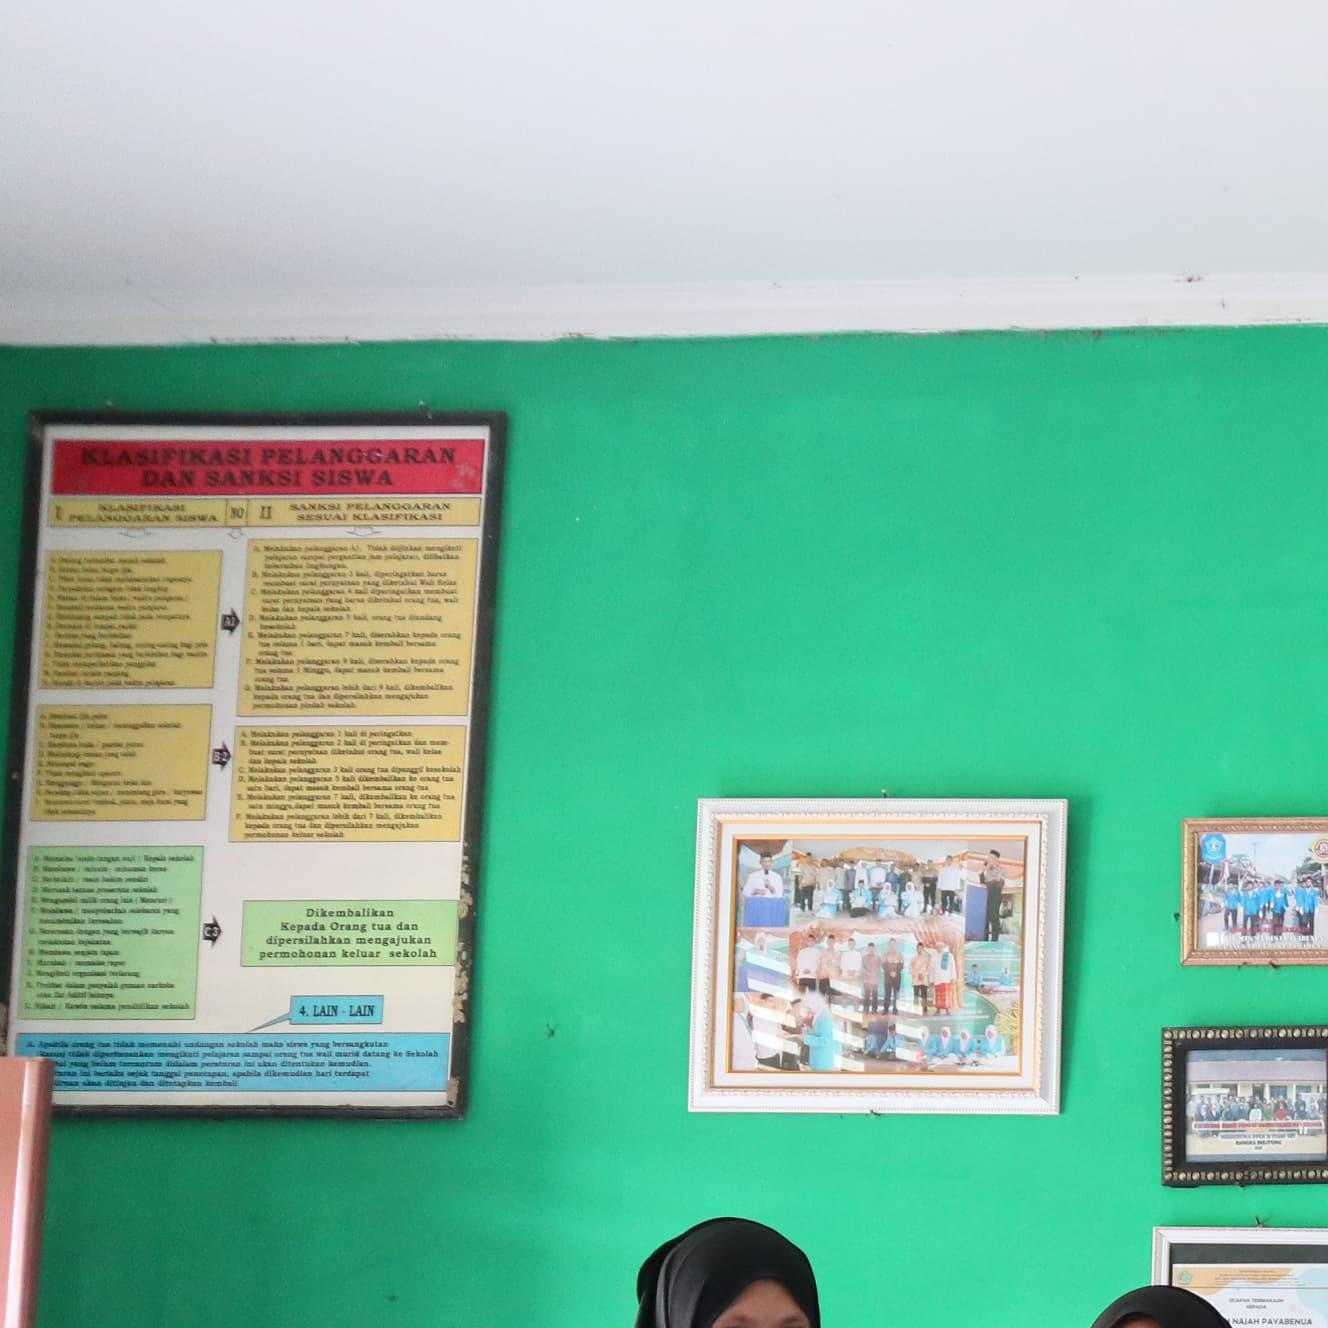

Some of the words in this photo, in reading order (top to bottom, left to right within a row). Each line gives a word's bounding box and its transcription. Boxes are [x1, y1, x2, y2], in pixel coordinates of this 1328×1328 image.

[81, 448, 251, 465] KLASIFIKASI
[262, 448, 456, 465] PELANGGARAN
[142, 470, 196, 487] DAN
[207, 470, 302, 486] SANKSI
[314, 469, 392, 486] SISWA
[289, 503, 341, 511] SANKSI
[347, 502, 451, 511] PELANGGARAN
[296, 513, 347, 521] SESUAI
[353, 512, 442, 521] KLASIFIKASI
[306, 908, 394, 917] Dikembalikan
[280, 922, 325, 933] Kepada
[330, 922, 367, 932] Orang
[372, 923, 391, 931] tua
[396, 922, 418, 930] dan
[266, 936, 351, 946] dipersilahkan
[356, 936, 431, 946] mengajukan
[259, 950, 336, 960] permohonan
[341, 949, 381, 958] keluar
[389, 949, 437, 958] sekolah
[299, 1006, 309, 1016] 4.
[313, 1005, 338, 1016] LAIN
[349, 1005, 375, 1016] LAIN
[332, 1041, 388, 1049] bersangkutan
